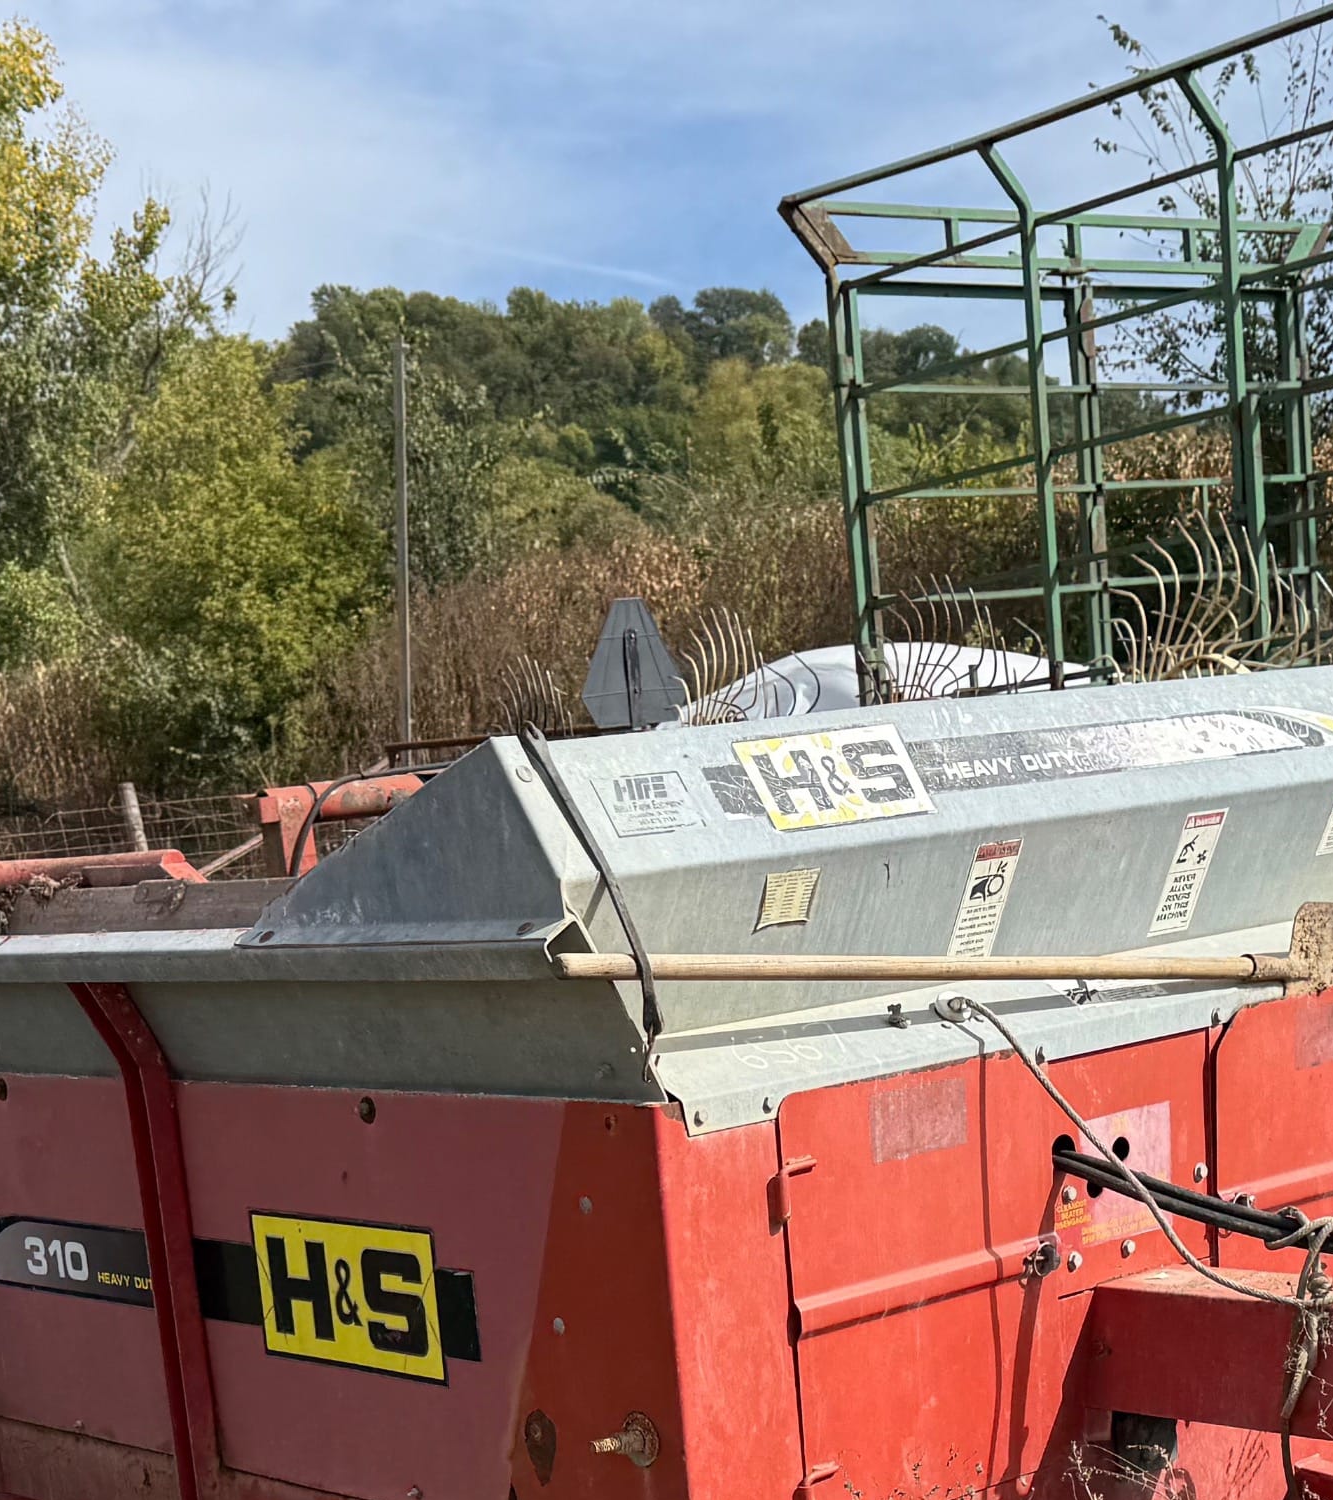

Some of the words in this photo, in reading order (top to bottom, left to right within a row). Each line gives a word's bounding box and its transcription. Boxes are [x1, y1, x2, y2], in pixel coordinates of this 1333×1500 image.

[752, 739, 916, 814] H&S
[943, 756, 1013, 780] HEAVY
[1021, 750, 1080, 773] DUTY
[1173, 873, 1197, 883] NEVER
[1169, 883, 1194, 893] ALLOW
[1161, 903, 1172, 913] ON
[1155, 909, 1188, 922] MACHINE
[24, 1236, 89, 1282] 310
[97, 1271, 131, 1289] HEAVY
[133, 1276, 154, 1291] DUT
[265, 1236, 429, 1358] H&S
